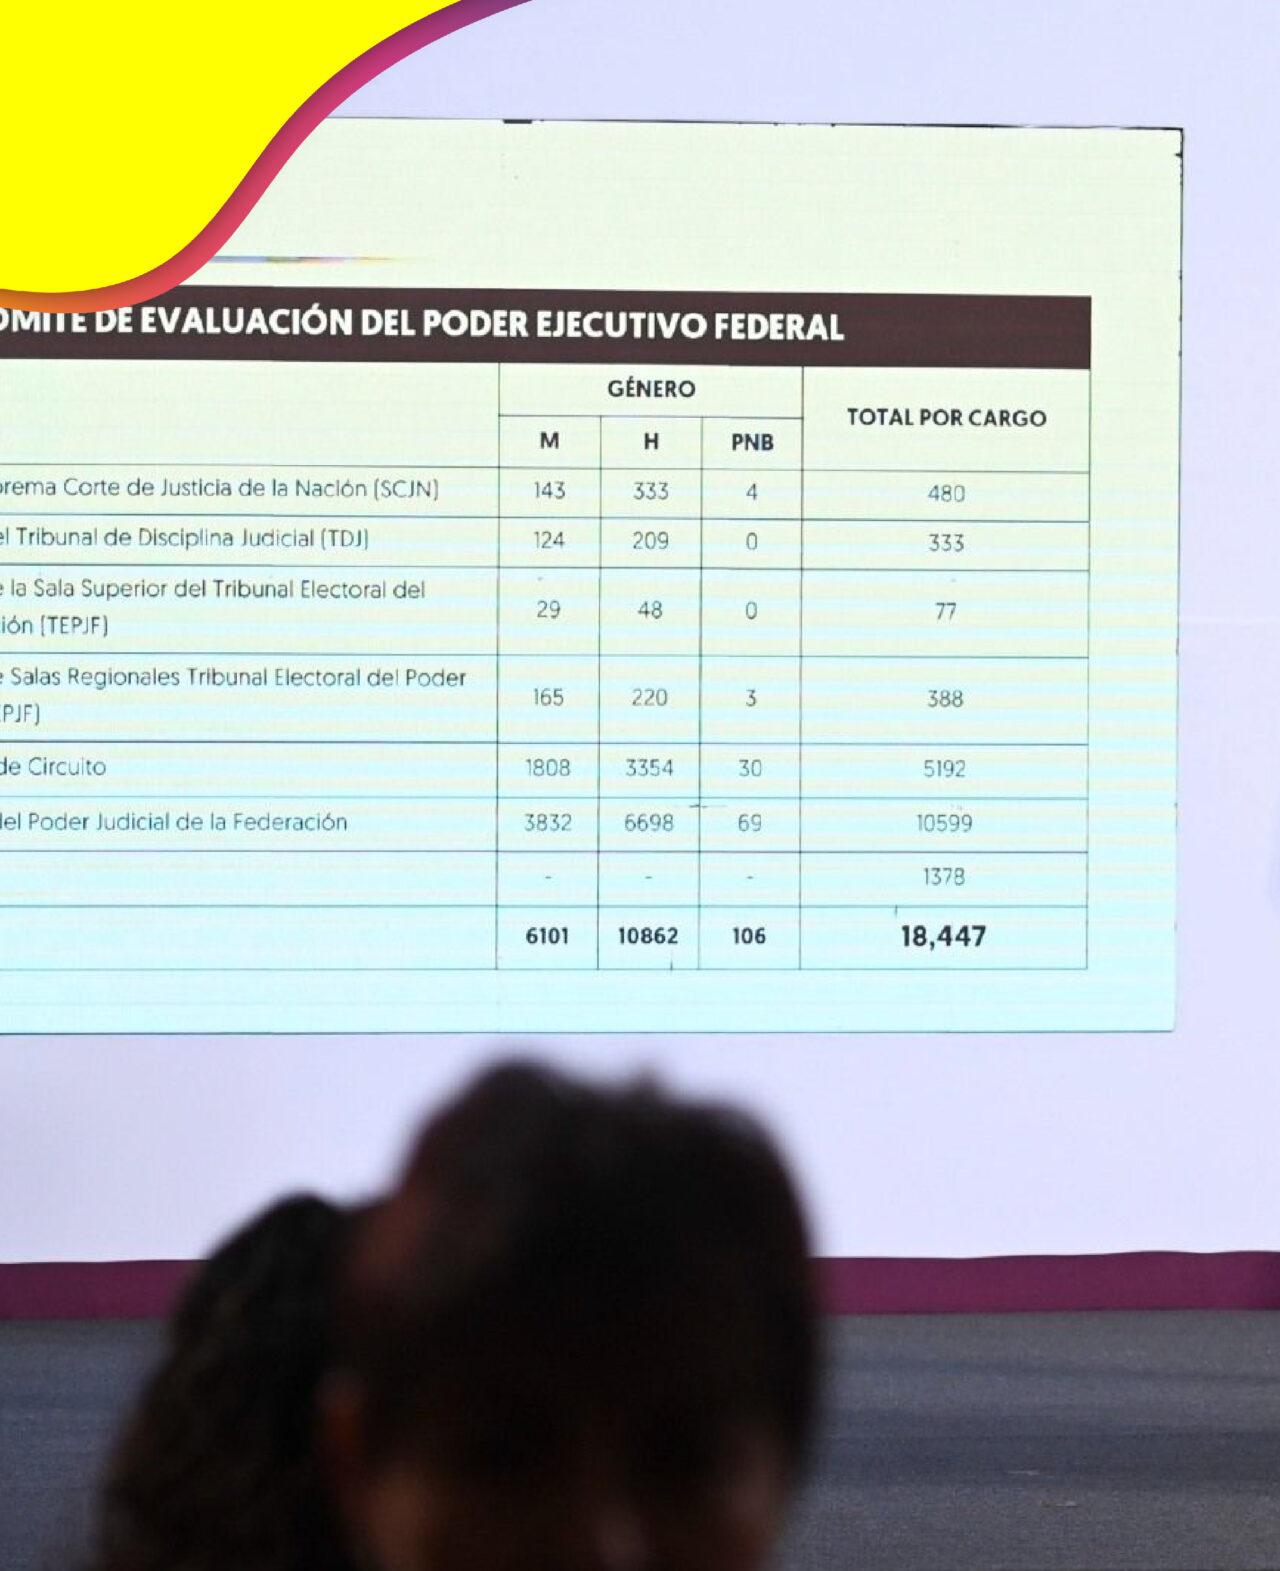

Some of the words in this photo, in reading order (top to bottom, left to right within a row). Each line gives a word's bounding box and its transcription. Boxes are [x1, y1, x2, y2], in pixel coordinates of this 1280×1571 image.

[95, 307, 133, 333] DE
[141, 303, 353, 336] EVALUACIÓN
[361, 308, 416, 336] DEL
[423, 309, 529, 338] PODER
[536, 310, 708, 339] EJECUTIVO
[715, 312, 845, 341] FEDERAL
[606, 377, 697, 399] GÉNERO
[846, 406, 915, 427] TOTAL
[919, 407, 963, 427] POR
[968, 408, 1048, 428] CARGO
[539, 430, 560, 450] M
[643, 431, 660, 451] H
[731, 432, 775, 453] PNB
[63, 477, 121, 497] Corte
[126, 476, 156, 497] de
[160, 477, 233, 497] Justicia
[237, 477, 266, 497] de
[271, 477, 289, 497] la
[295, 476, 368, 498] Nación
[373, 477, 439, 502] (SCJN)
[534, 480, 566, 501] 143
[632, 480, 669, 501] 333
[745, 482, 759, 501] 4
[927, 484, 967, 504] 480
[15, 526, 98, 547] Tribunal
[103, 526, 133, 547] de
[138, 526, 234, 552] Disciplina
[241, 527, 315, 549] Judicial
[320, 527, 369, 551] (TDJ)
[533, 530, 566, 550] 124
[632, 530, 669, 550] 209
[745, 531, 758, 551] 0
[928, 532, 965, 553] 333
[10, 577, 27, 598] la
[33, 577, 76, 598] Sala
[81, 577, 168, 602] Superior
[173, 578, 207, 599] del
[212, 578, 294, 599] Tribunal
[300, 579, 387, 600] Electoral
[392, 579, 426, 600] del
[536, 599, 562, 620] 29
[637, 600, 663, 620] 48
[745, 600, 758, 621] 0
[934, 601, 957, 621] 77
[40, 614, 109, 639] (TEPJF)
[10, 666, 61, 687] Salas
[67, 666, 181, 691] Regionales
[186, 666, 268, 687] Tribunal
[274, 667, 361, 688] Electoral
[366, 667, 399, 688] del
[405, 667, 467, 688] Poder
[533, 687, 564, 707] 165
[631, 687, 669, 707] 220
[745, 688, 758, 708] 3
[927, 689, 965, 709] 388
[28, 756, 107, 777] Circuito
[525, 757, 572, 777] 1808
[625, 758, 674, 777] 3354
[738, 758, 762, 778] 30
[924, 759, 966, 779] 5192
[28, 811, 91, 832] Poder
[95, 811, 170, 832] Judicial
[175, 811, 204, 832] de
[210, 811, 227, 832] la
[233, 810, 348, 832] Federación
[524, 812, 572, 832] 3832
[624, 812, 675, 833] 6698
[737, 813, 762, 833] 69
[916, 813, 973, 834] 10599
[923, 866, 966, 887] 1378
[525, 926, 569, 946] 6101
[617, 925, 679, 946] 10862
[731, 926, 767, 946] 106
[900, 924, 987, 953] 18,447
